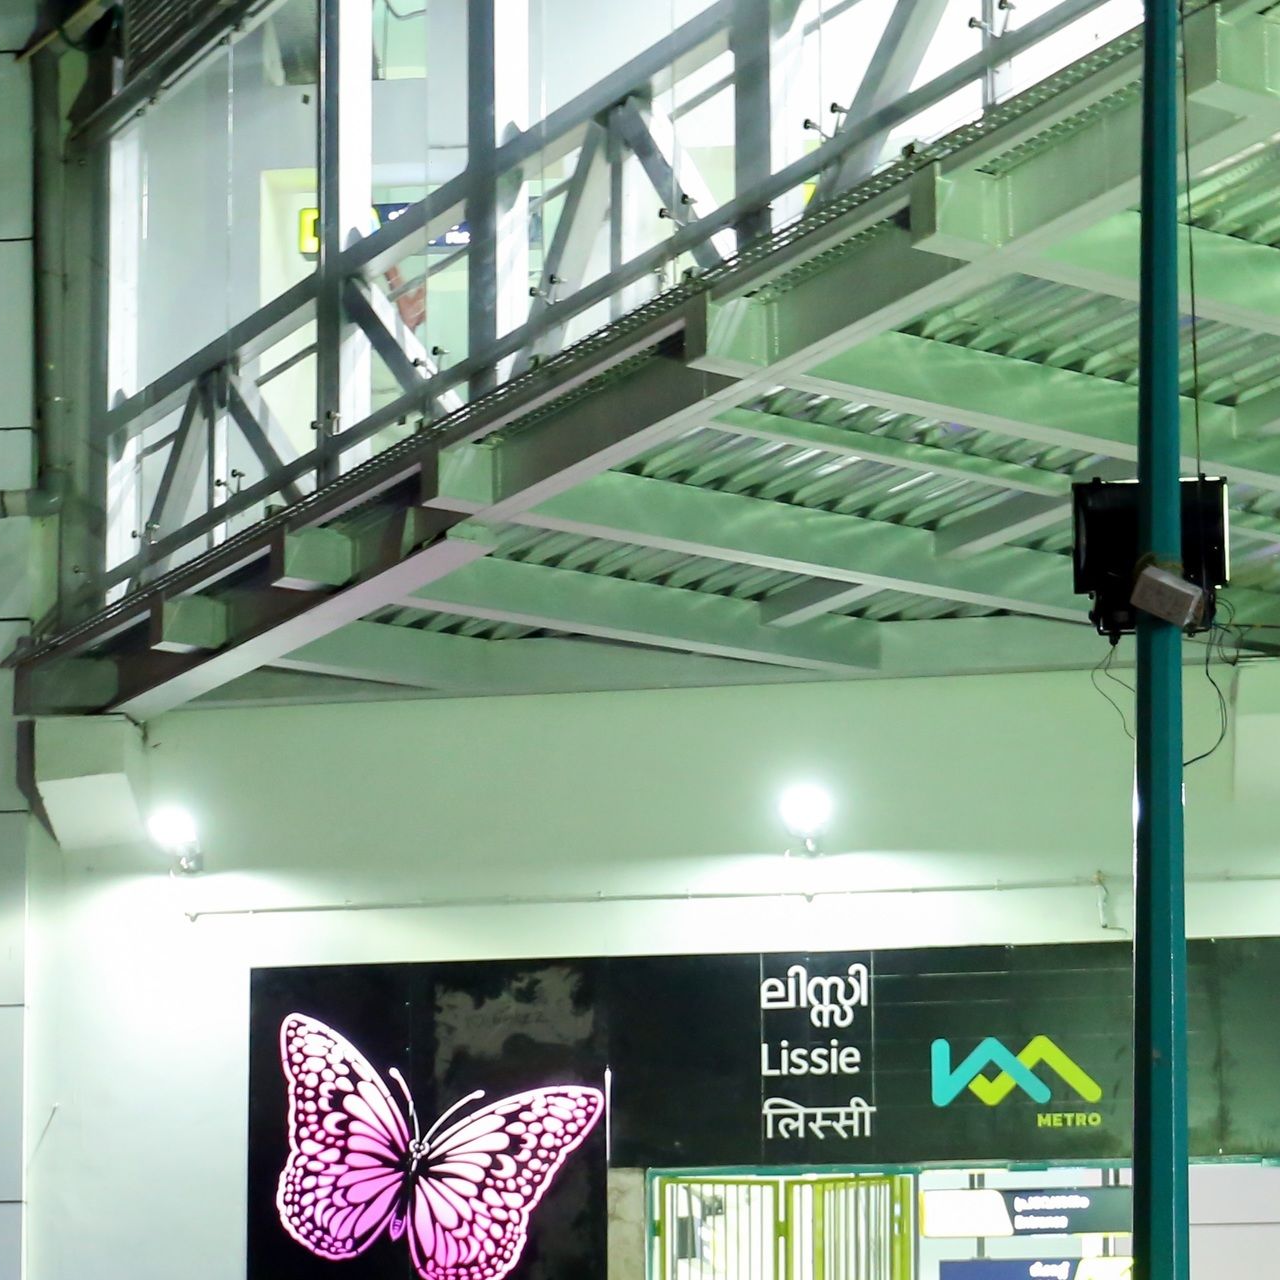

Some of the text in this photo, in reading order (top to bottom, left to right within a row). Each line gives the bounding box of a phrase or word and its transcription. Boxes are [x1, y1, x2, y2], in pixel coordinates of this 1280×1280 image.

[759, 962, 869, 1028] ലിസ്സി
[760, 1038, 862, 1077] Lissie
[762, 1096, 878, 1140] लिस्सी
[1036, 1112, 1103, 1128] METRO
